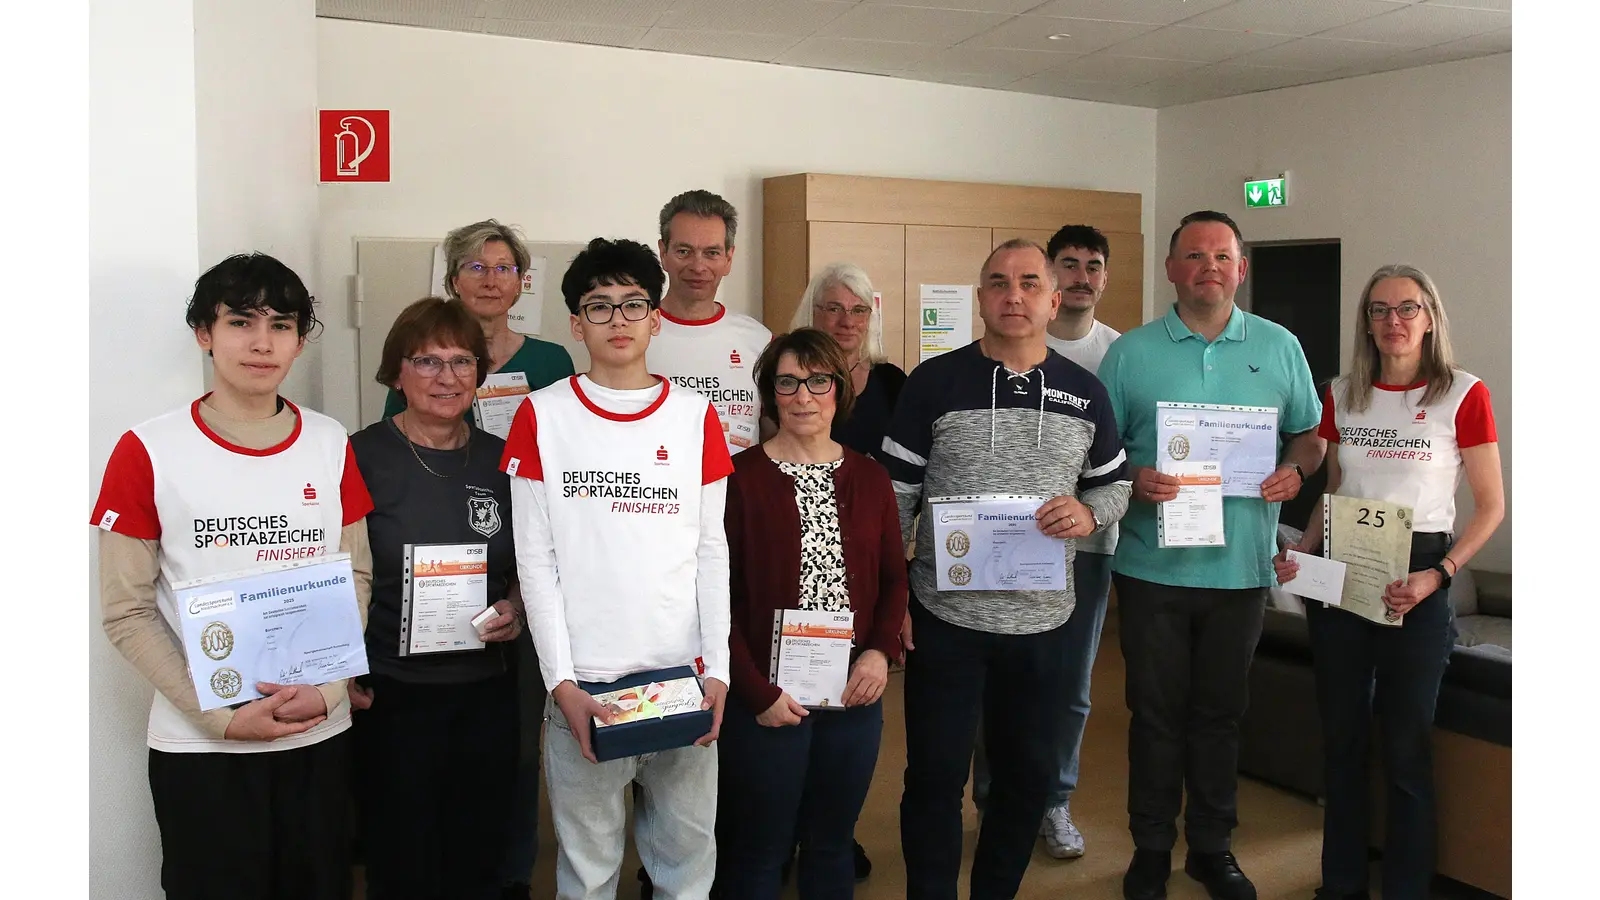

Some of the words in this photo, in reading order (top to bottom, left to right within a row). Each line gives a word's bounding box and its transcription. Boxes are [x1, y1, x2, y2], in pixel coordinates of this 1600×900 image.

[670, 376, 720, 388] TSCHES
[1042, 387, 1091, 410] MONTEREY
[1199, 420, 1272, 431] Familienurkunde
[1341, 427, 1397, 438] DEUTSCHES
[1339, 437, 1431, 449] SPORTABZEICHEN
[562, 471, 641, 485] DEUTSCHES
[562, 485, 678, 500] SPORTABZEICHEN
[611, 501, 680, 514] FINISHER'25
[194, 515, 289, 533] DEUTSCHES
[1357, 507, 1386, 528] 25
[194, 528, 325, 549] SPORTABZEICHEN
[240, 575, 347, 603] Familienurkunde
